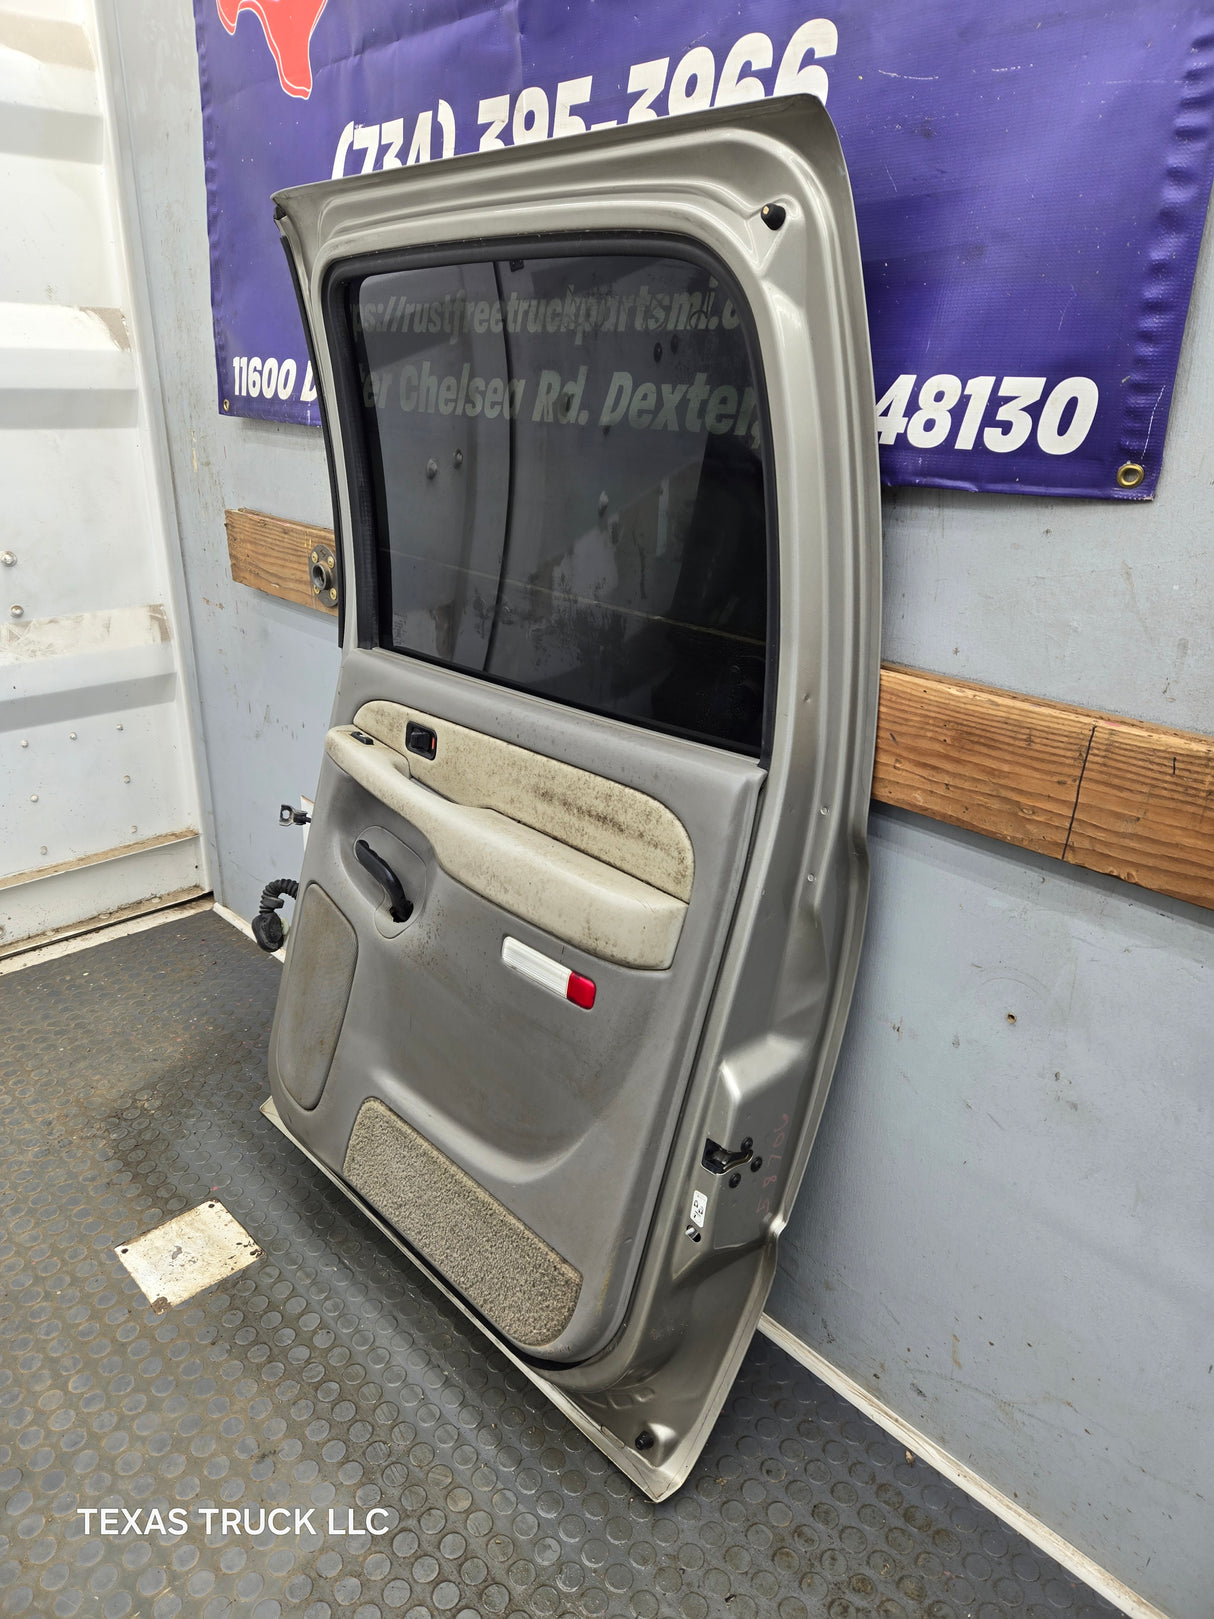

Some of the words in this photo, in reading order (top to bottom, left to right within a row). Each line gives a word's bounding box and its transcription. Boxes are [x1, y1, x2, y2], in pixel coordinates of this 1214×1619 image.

[331, 98, 456, 180] (734)
[477, 18, 838, 152] 395-3966
[233, 356, 297, 400] 11600
[399, 361, 527, 420] Chelsea
[532, 365, 589, 426] Rd.
[875, 374, 1099, 456] 48130
